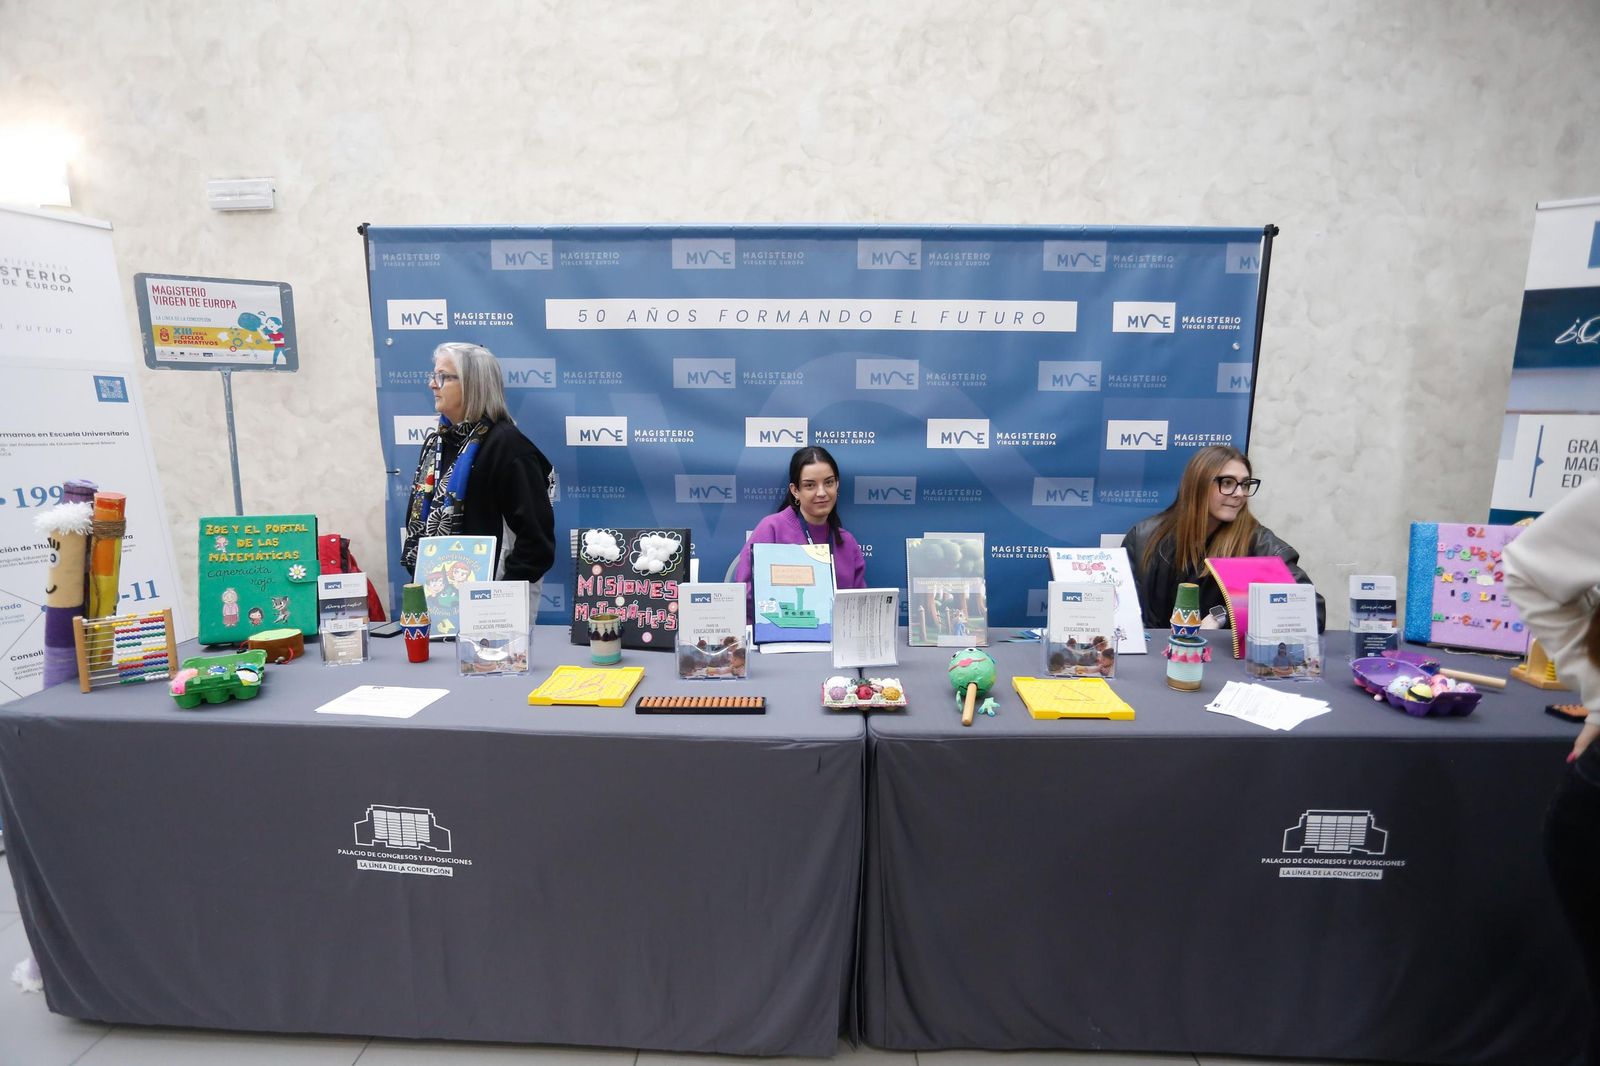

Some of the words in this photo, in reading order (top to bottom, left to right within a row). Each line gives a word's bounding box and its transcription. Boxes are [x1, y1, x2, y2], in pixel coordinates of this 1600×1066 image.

[2, 278, 17, 287] DE
[25, 280, 74, 294] EUROPA
[151, 285, 206, 297] MAGISTERIO
[152, 296, 186, 306] VIRGEN
[190, 297, 200, 307] DE
[204, 299, 237, 309] EUROPA
[579, 310, 606, 322] 50
[627, 307, 697, 322] AÑOS
[719, 310, 872, 323] FORMANDO
[895, 310, 917, 324] EL
[941, 311, 1045, 324] FUTURO
[206, 524, 228, 536] ZOE
[232, 525, 239, 534] Y
[245, 526, 260, 534] EL
[265, 524, 308, 534] PORTAL
[237, 538, 253, 548] DE
[258, 538, 279, 547] LAS
[377, 852, 418, 861] CONGRESOS
[424, 856, 472, 865] EXPOSICIONES
[407, 866, 450, 875] CONCEPCIÓN
